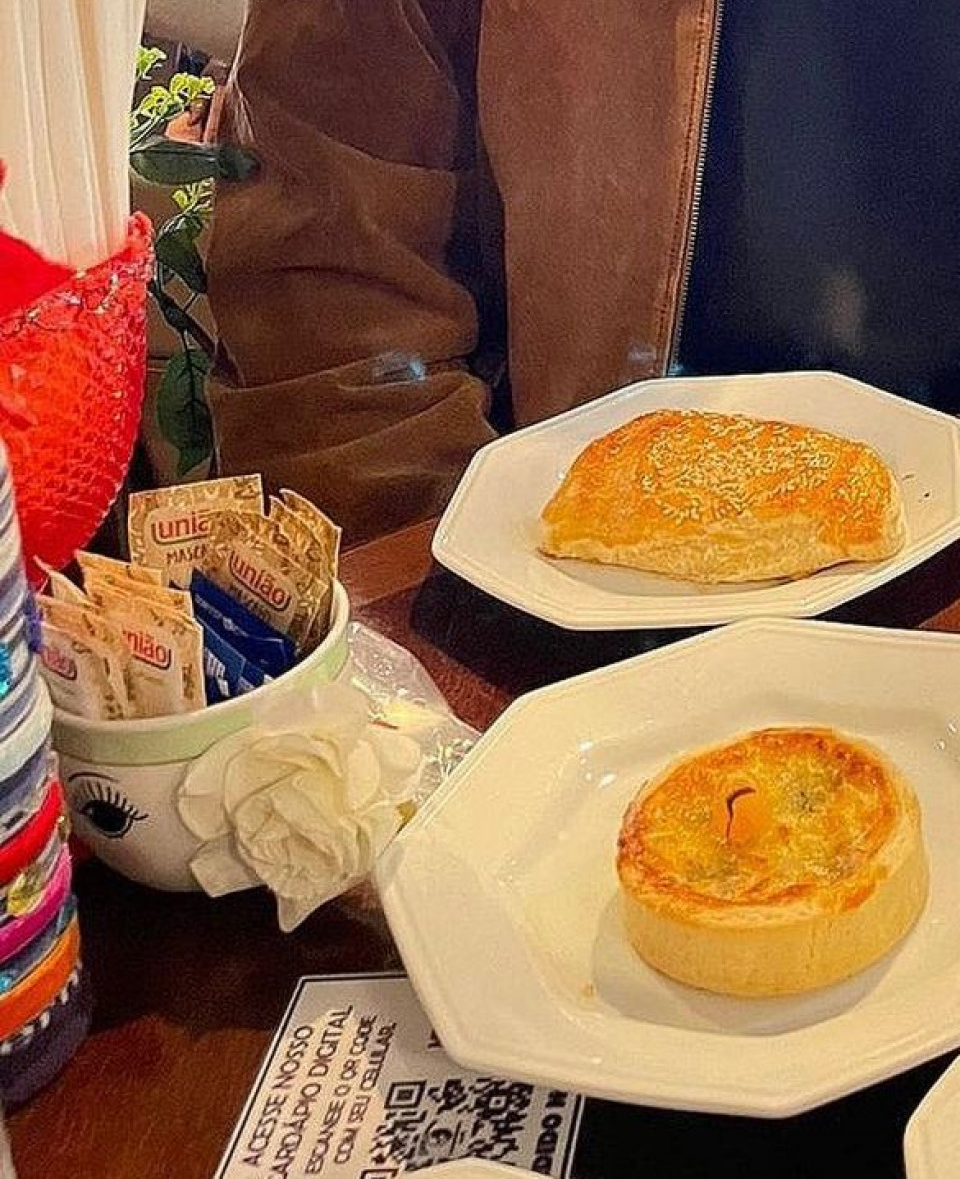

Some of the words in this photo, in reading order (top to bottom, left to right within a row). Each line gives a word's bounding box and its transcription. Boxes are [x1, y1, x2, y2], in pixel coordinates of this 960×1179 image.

[231, 552, 288, 607] união
[122, 629, 168, 664] nião
[309, 1005, 354, 1077] DIGITAL
[350, 1015, 377, 1055] CODE
[334, 1084, 350, 1097] O
[341, 1059, 357, 1081] QR
[242, 1094, 287, 1167] ACESSE
[271, 1025, 314, 1090] NOSSO
[334, 1127, 359, 1164] COM
[349, 1095, 372, 1123] SEU
